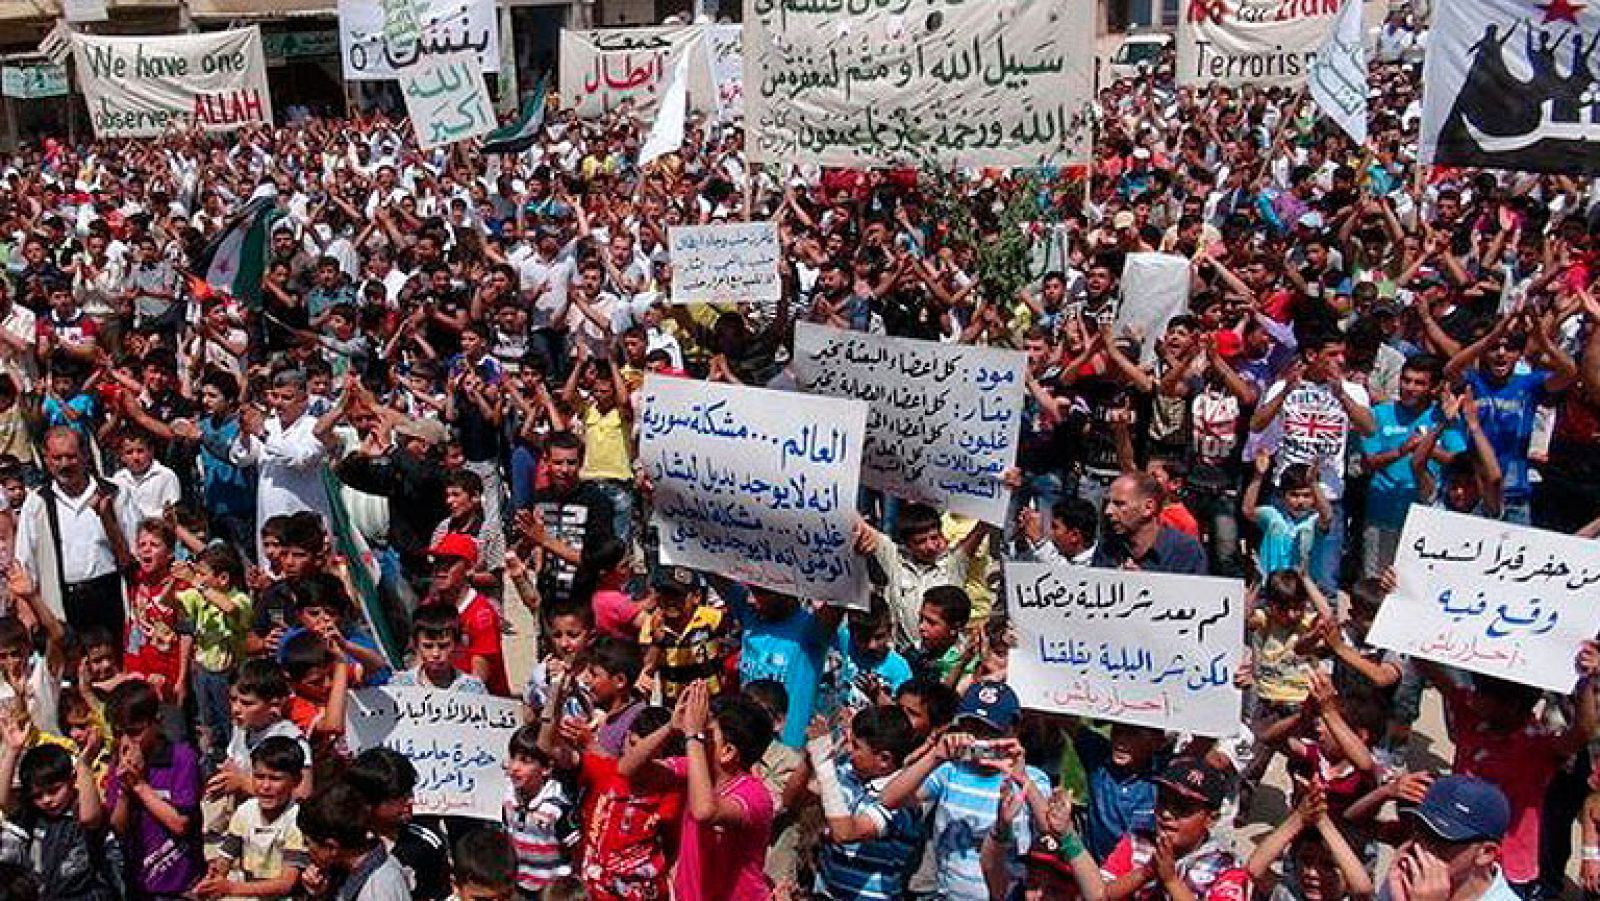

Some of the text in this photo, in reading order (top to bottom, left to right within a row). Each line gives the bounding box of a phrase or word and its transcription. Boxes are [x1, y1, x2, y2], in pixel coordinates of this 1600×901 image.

[85, 44, 245, 78] We have one
[195, 88, 263, 124] ALLAH
[935, 355, 962, 382] كل
[690, 400, 748, 438] مشكلة
[924, 388, 950, 415] كل
[923, 423, 948, 445] كل
[1077, 581, 1124, 619] البلية
[1116, 588, 1153, 618] شر
[1438, 590, 1558, 637] وقع فيه
[1151, 607, 1196, 634] يعد
[1198, 597, 1230, 643] لم
[1099, 643, 1152, 681] البلية
[1151, 654, 1185, 684] شر
[1186, 652, 1229, 691] لكن
